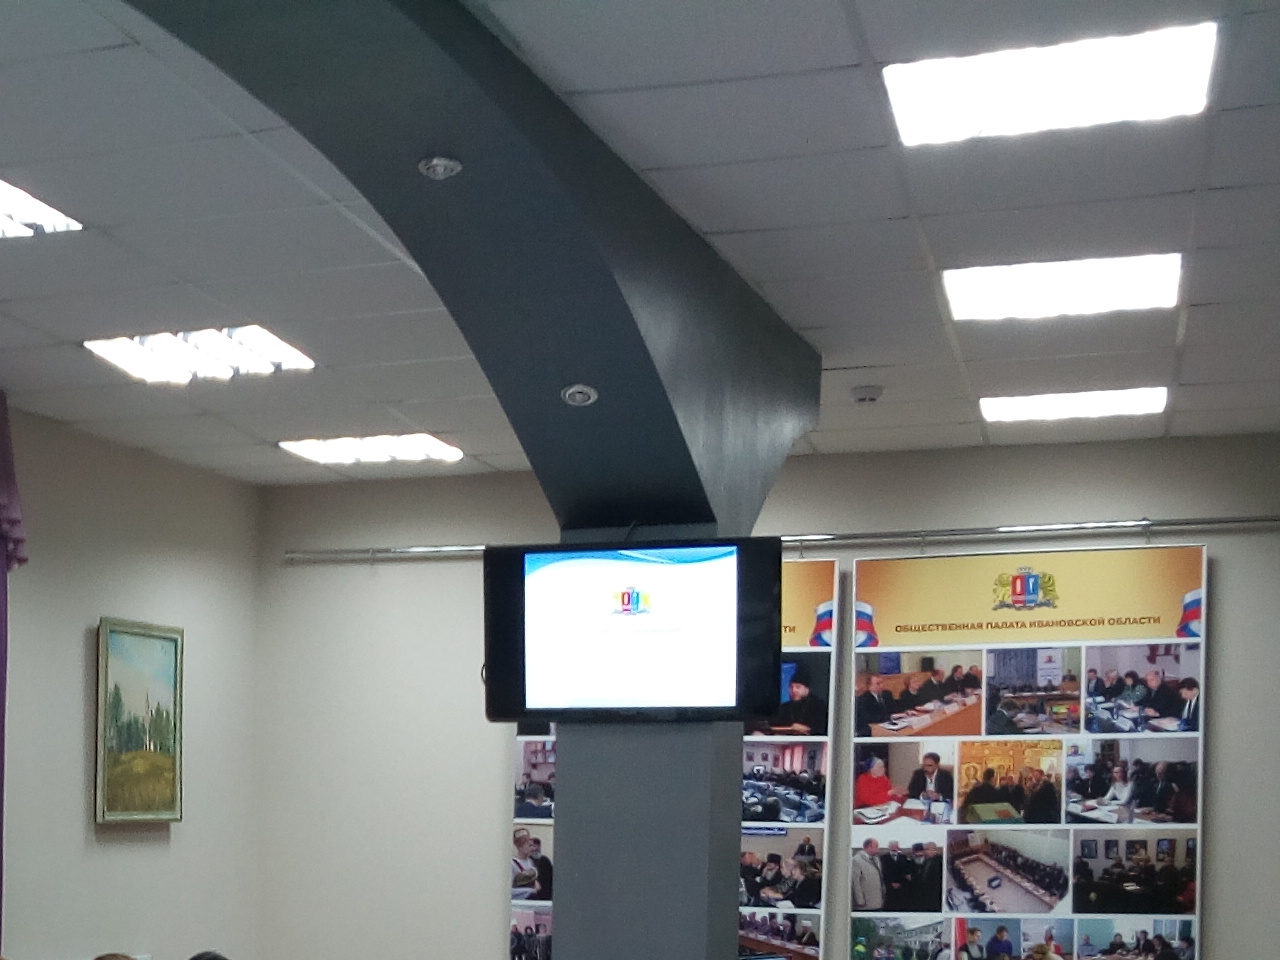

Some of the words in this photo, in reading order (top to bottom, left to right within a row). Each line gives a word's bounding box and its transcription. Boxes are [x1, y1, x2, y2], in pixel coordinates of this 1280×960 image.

[895, 622, 983, 633] ОБЩЕСТВЕННАЯ
[986, 620, 1027, 630] ПАЛАТА
[1029, 617, 1105, 628] ИВАНОВСКОЙ
[1108, 616, 1161, 626] ОБЛАСТИ
